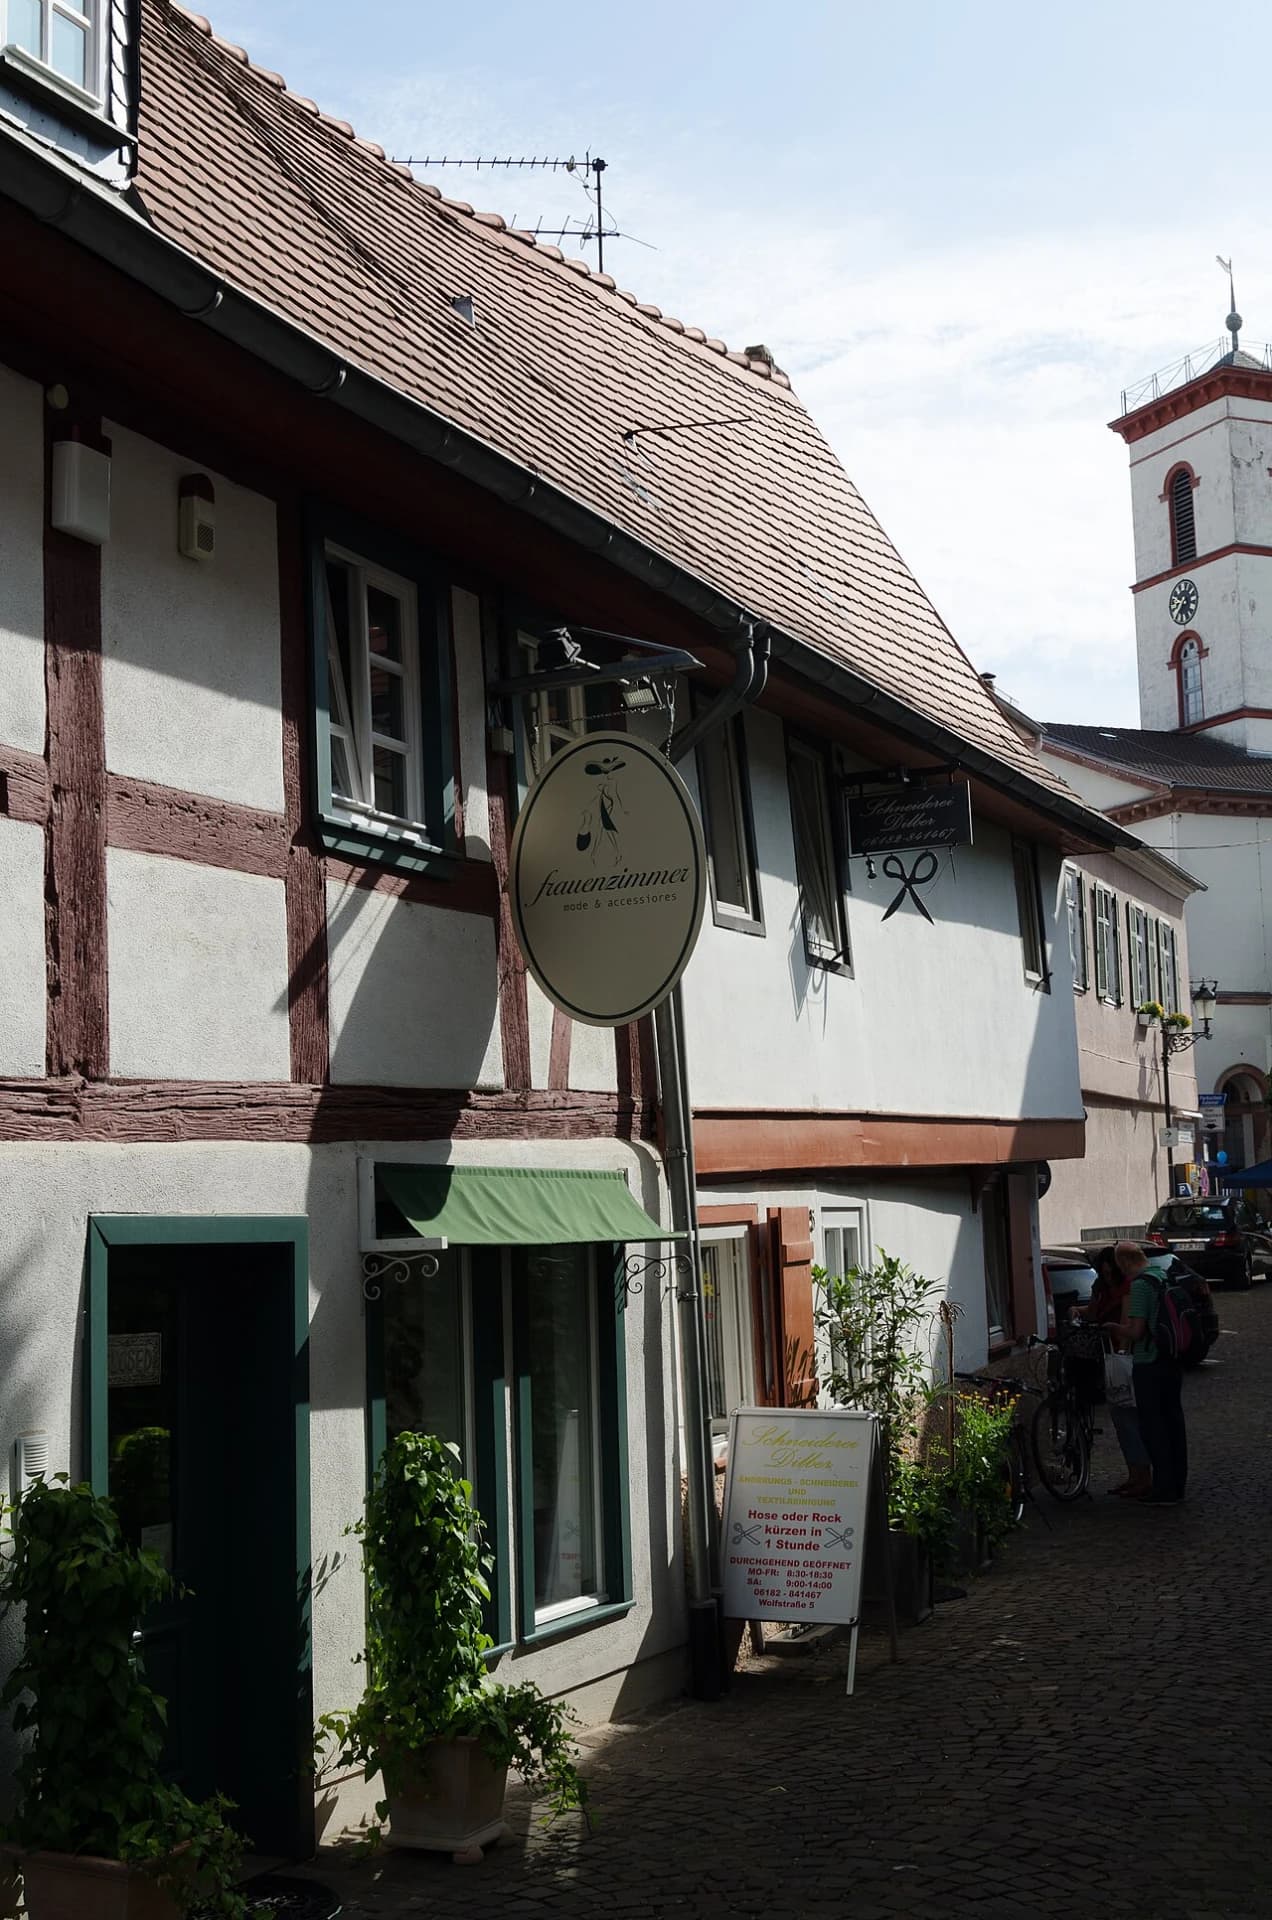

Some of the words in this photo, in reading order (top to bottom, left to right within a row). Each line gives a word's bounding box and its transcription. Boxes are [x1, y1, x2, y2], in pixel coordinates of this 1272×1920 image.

[523, 865, 689, 908] frauenzimmer
[563, 900, 588, 912] mode
[594, 899, 601, 909] &
[1179, 1186, 1187, 1195] P
[763, 1448, 834, 1469] Dilber
[788, 1487, 807, 1496] UND
[748, 1509, 778, 1520] Hose
[782, 1512, 808, 1522] oder
[812, 1513, 842, 1523] Rock
[764, 1525, 806, 1536] kürzen
[811, 1526, 822, 1537] in
[764, 1539, 771, 1549] 1
[776, 1539, 820, 1551] Stunde
[730, 1556, 800, 1568] DURCHGEHEND
[803, 1559, 851, 1570] GEÖFFNET
[747, 1568, 780, 1577] MO-FR:
[787, 1570, 833, 1579] 8:30-18:30
[747, 1578, 762, 1586] SA:
[786, 1580, 832, 1589] 9:00-14:00
[754, 1589, 781, 1597] 06182
[789, 1590, 821, 1599] 841467
[759, 1599, 806, 1609] Wolfstraße
